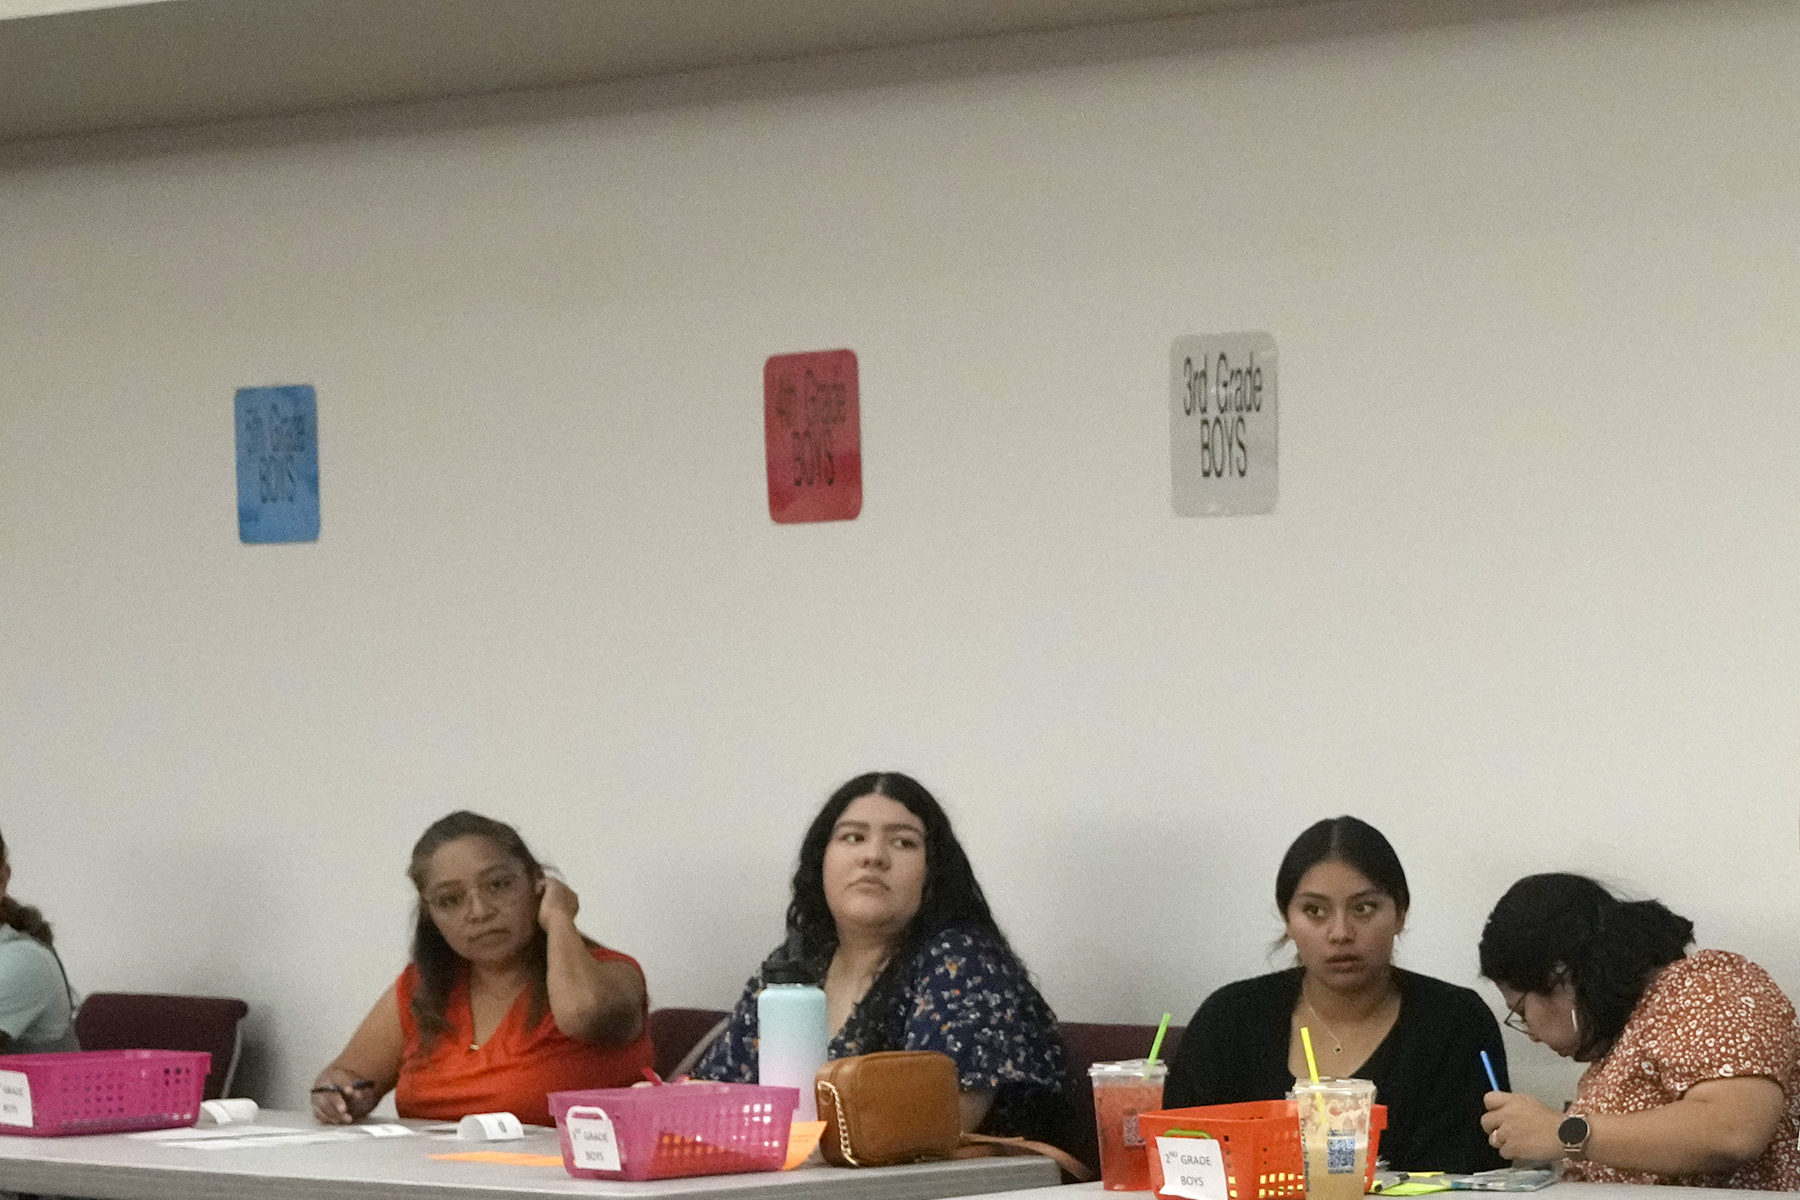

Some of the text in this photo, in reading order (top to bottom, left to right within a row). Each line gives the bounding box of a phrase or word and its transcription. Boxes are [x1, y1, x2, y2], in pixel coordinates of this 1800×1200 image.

[1183, 352, 1263, 416] 3rd Grade
[1200, 415, 1247, 478] BOYS
[1180, 1154, 1211, 1166] GRADE
[1180, 1175, 1204, 1187] BOYS
